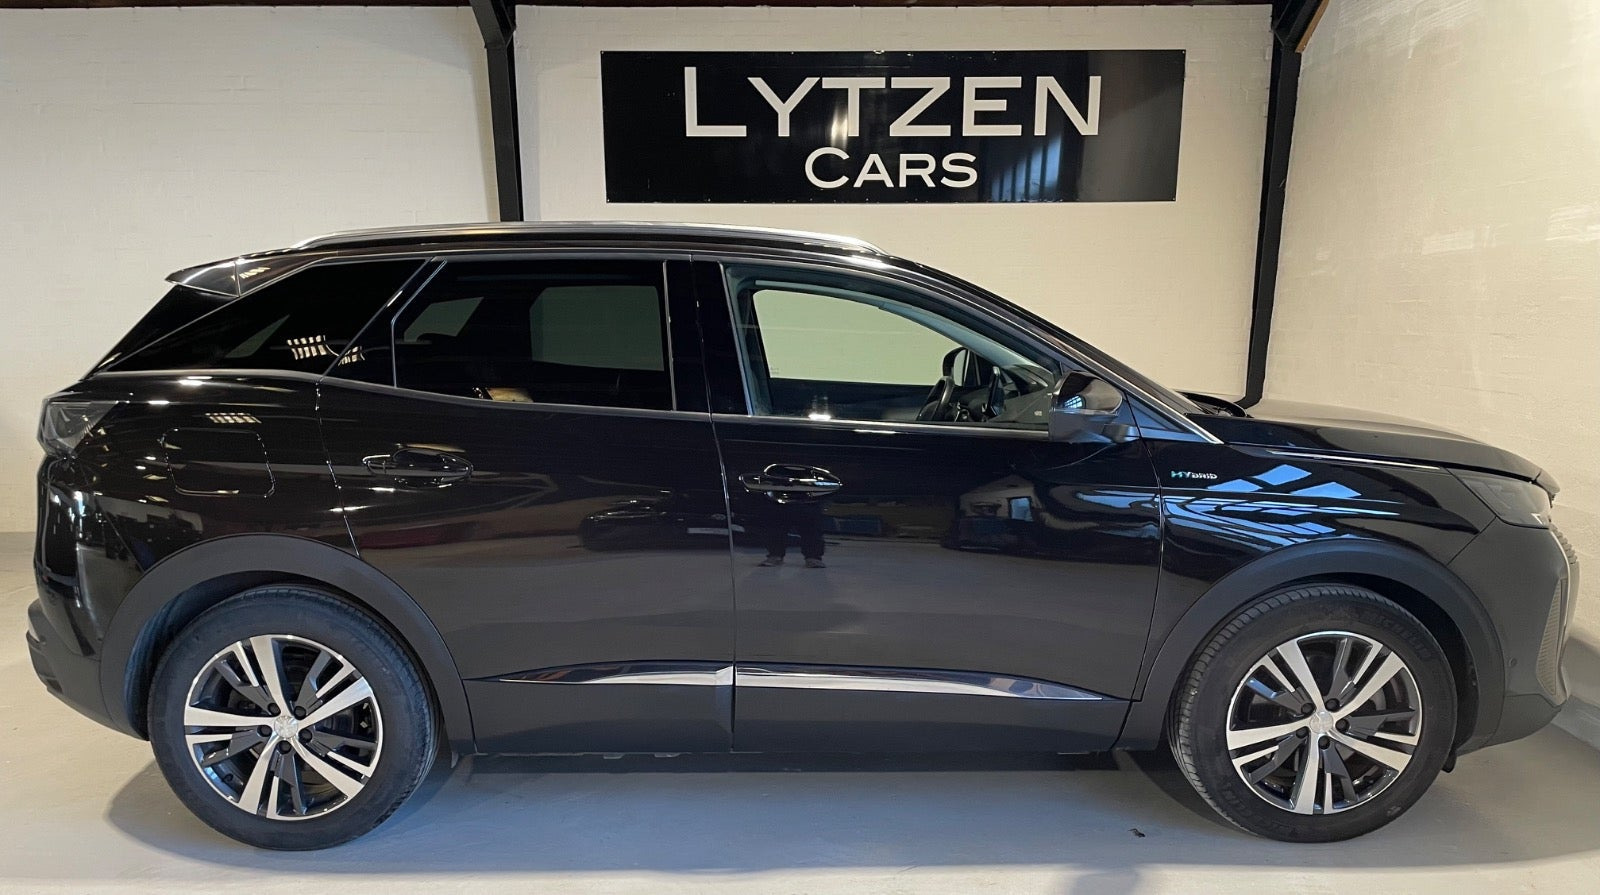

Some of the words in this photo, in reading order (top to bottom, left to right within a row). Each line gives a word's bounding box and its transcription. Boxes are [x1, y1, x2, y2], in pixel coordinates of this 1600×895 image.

[684, 66, 1102, 137] LYTZEN
[804, 146, 978, 189] CARS
[1171, 470, 1218, 480] HYBRID
